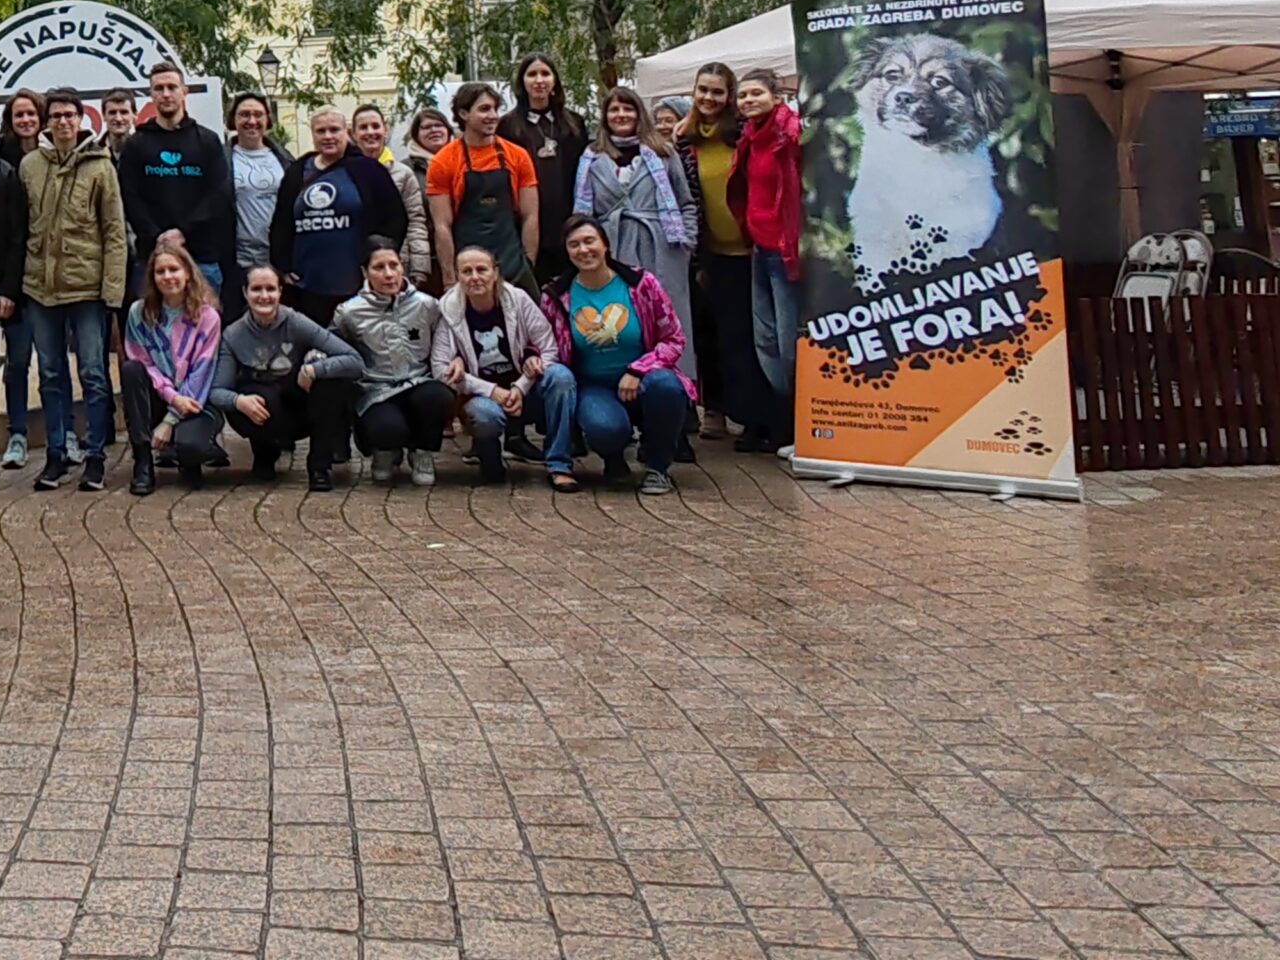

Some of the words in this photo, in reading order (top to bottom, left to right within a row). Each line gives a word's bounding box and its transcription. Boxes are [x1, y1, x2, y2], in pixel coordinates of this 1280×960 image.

[806, 3, 863, 20] SKLONIŠTE
[866, 3, 882, 13] ZA
[807, 15, 857, 33] GRADA
[861, 9, 935, 26] ZAGREBA
[941, 1, 1025, 20] DUMOVEC
[144, 163, 179, 178] Project
[807, 251, 1040, 341] UDOMLJAVANJE
[846, 328, 887, 366] JE
[890, 291, 1026, 353] FORA!
[966, 439, 1021, 454] DUMOVEC
